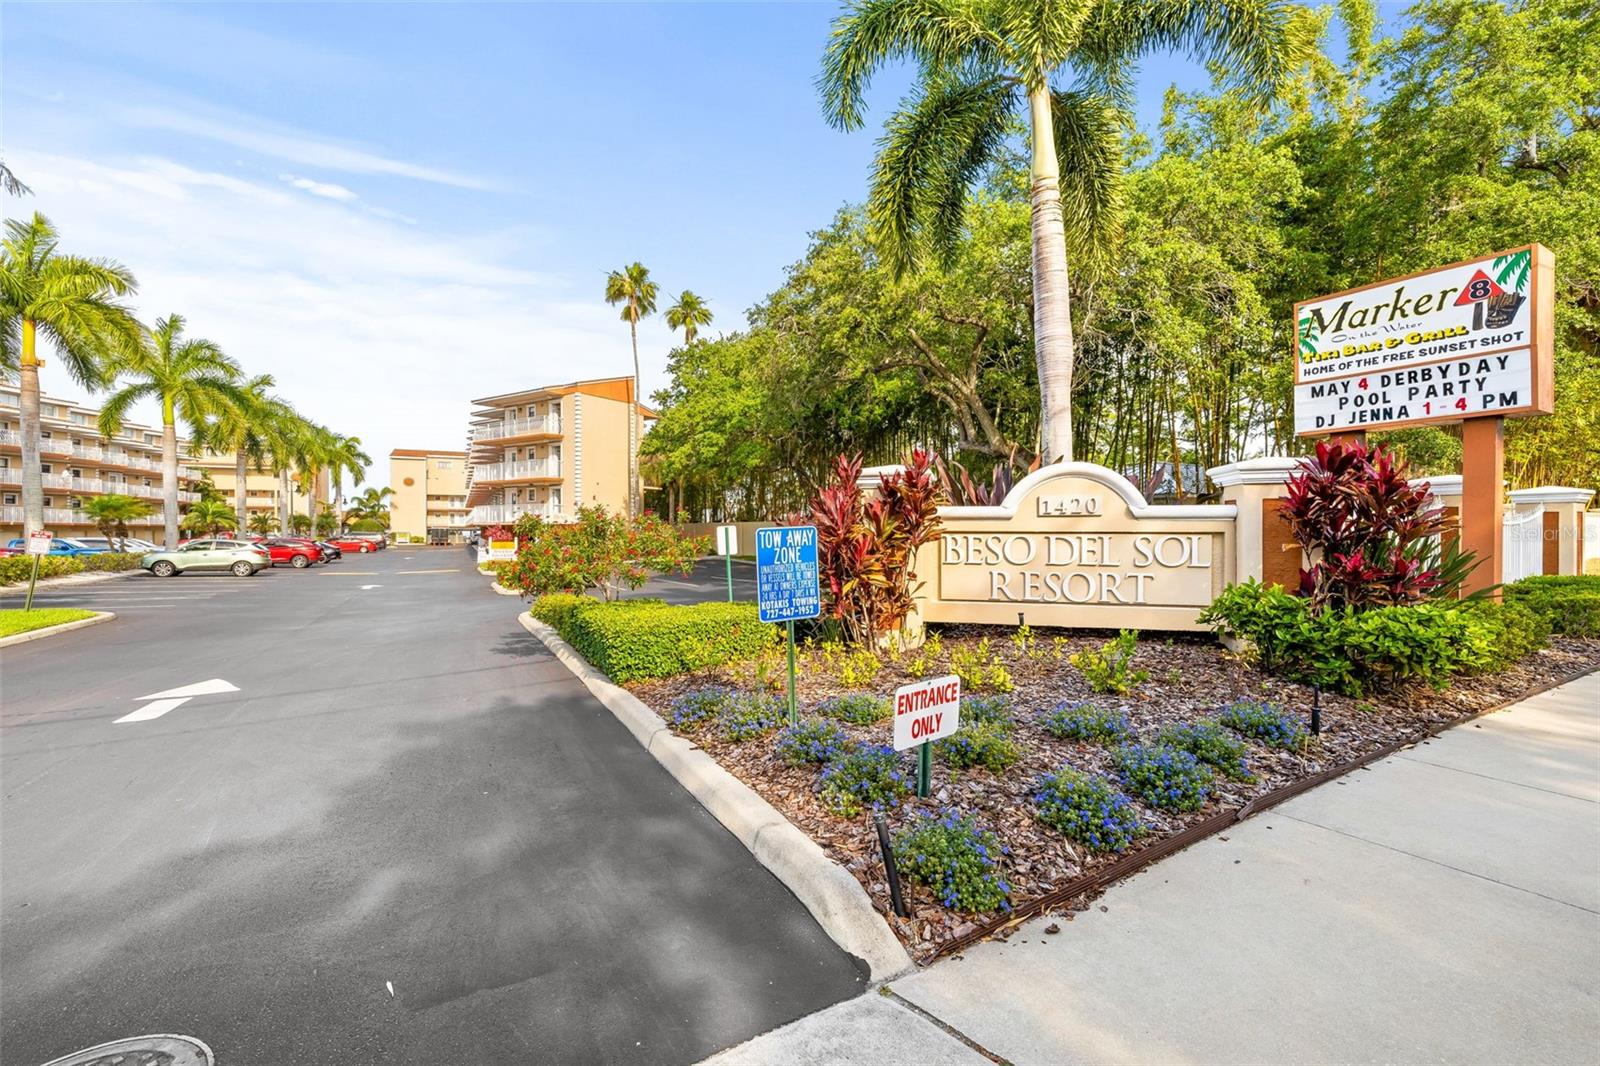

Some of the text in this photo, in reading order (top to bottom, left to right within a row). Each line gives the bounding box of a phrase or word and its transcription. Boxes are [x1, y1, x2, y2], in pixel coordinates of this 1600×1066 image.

[1304, 279, 1492, 339] Marker 8
[1331, 334, 1356, 343] On
[1380, 322, 1422, 333] Water
[1384, 338, 1403, 349] &
[1303, 331, 1524, 376] HOME OF THE FREE SUNSET SHOT
[1311, 380, 1350, 398] MAY
[1358, 378, 1368, 390] 4
[1339, 376, 1487, 410] POOL PARTY
[1316, 414, 1335, 428] DJ
[1349, 405, 1410, 424] JENNA
[1482, 391, 1518, 409] PM
[1041, 497, 1098, 516] 1420
[759, 529, 814, 548] TOW AWAY
[774, 547, 802, 564] ZONE
[942, 535, 1211, 568] BESO DEL SOL
[989, 570, 1154, 604] RESORT
[761, 596, 817, 610] KOTAKIS TOWING
[766, 605, 814, 619] 727-447-1952
[897, 682, 958, 716] ENTRANCE
[911, 712, 943, 739] ONLY
